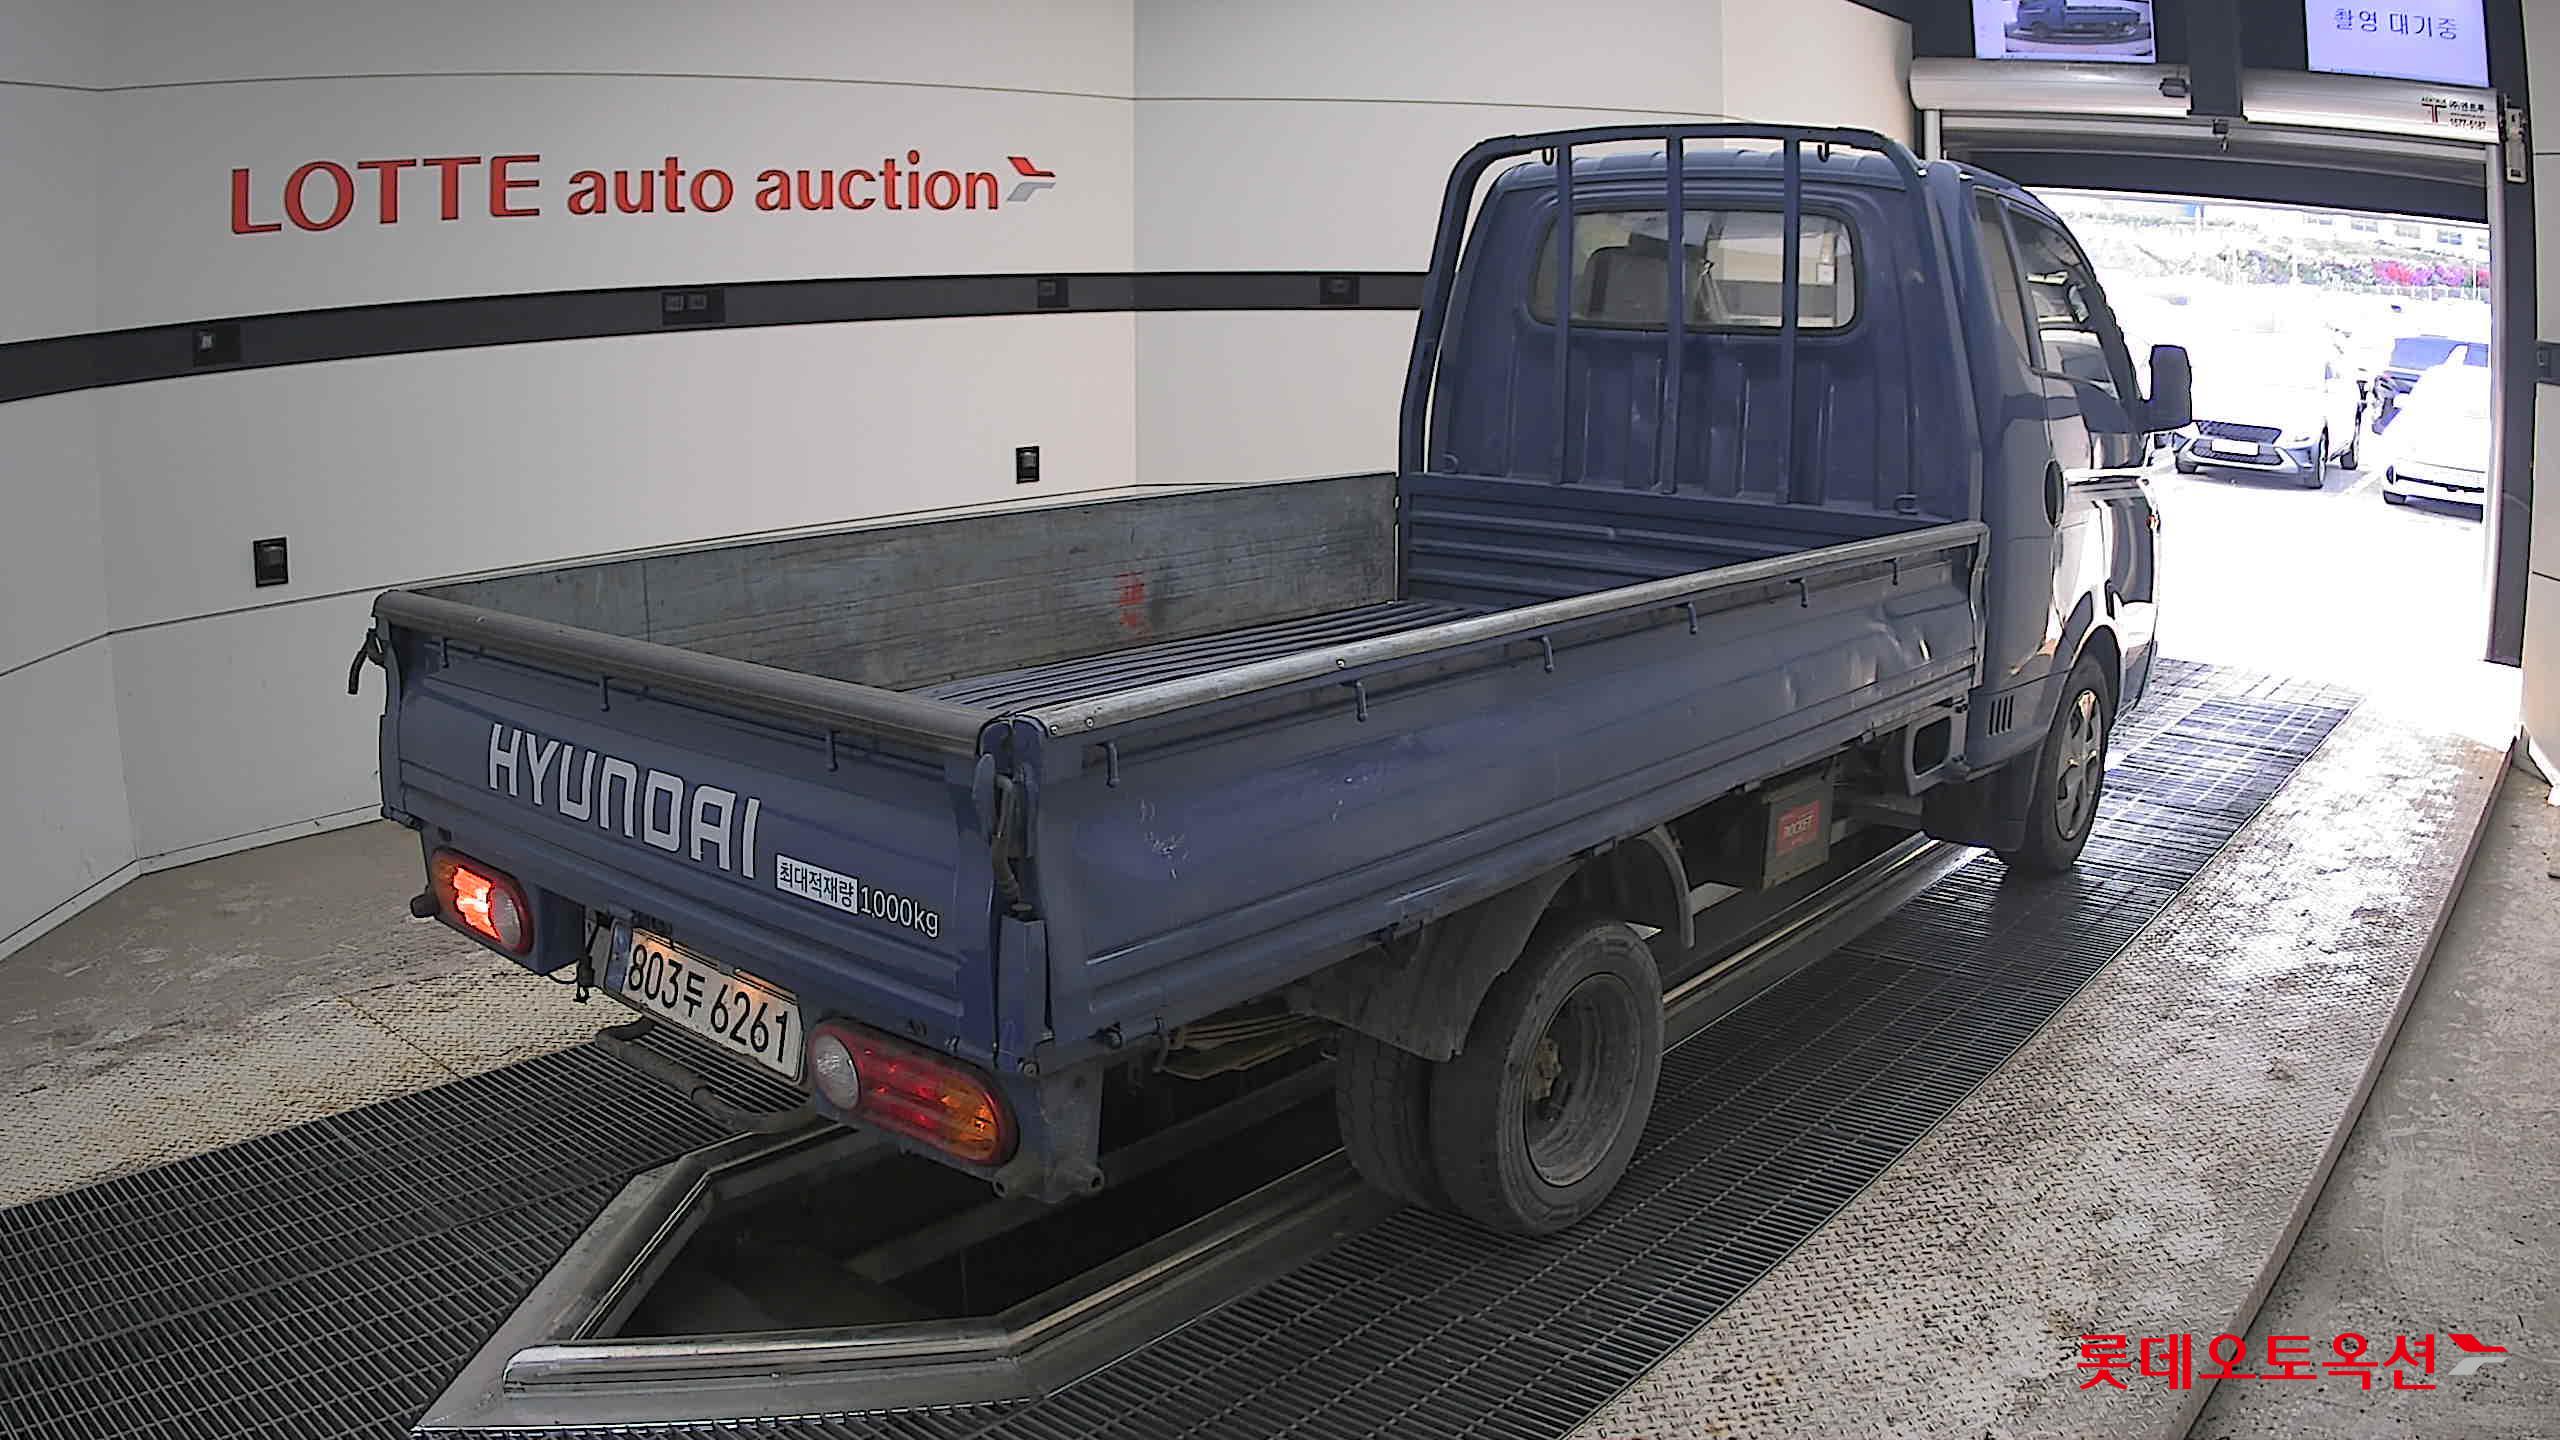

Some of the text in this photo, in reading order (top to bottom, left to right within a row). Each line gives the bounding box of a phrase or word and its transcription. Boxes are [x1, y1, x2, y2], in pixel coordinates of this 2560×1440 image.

[2335, 8, 2457, 40] 촬영 대기중
[230, 149, 1000, 235] LOTTE auto auction
[488, 722, 761, 879] HYUNDAI
[779, 861, 854, 909] 최대적재량
[628, 943, 789, 1064] 803두 6261
